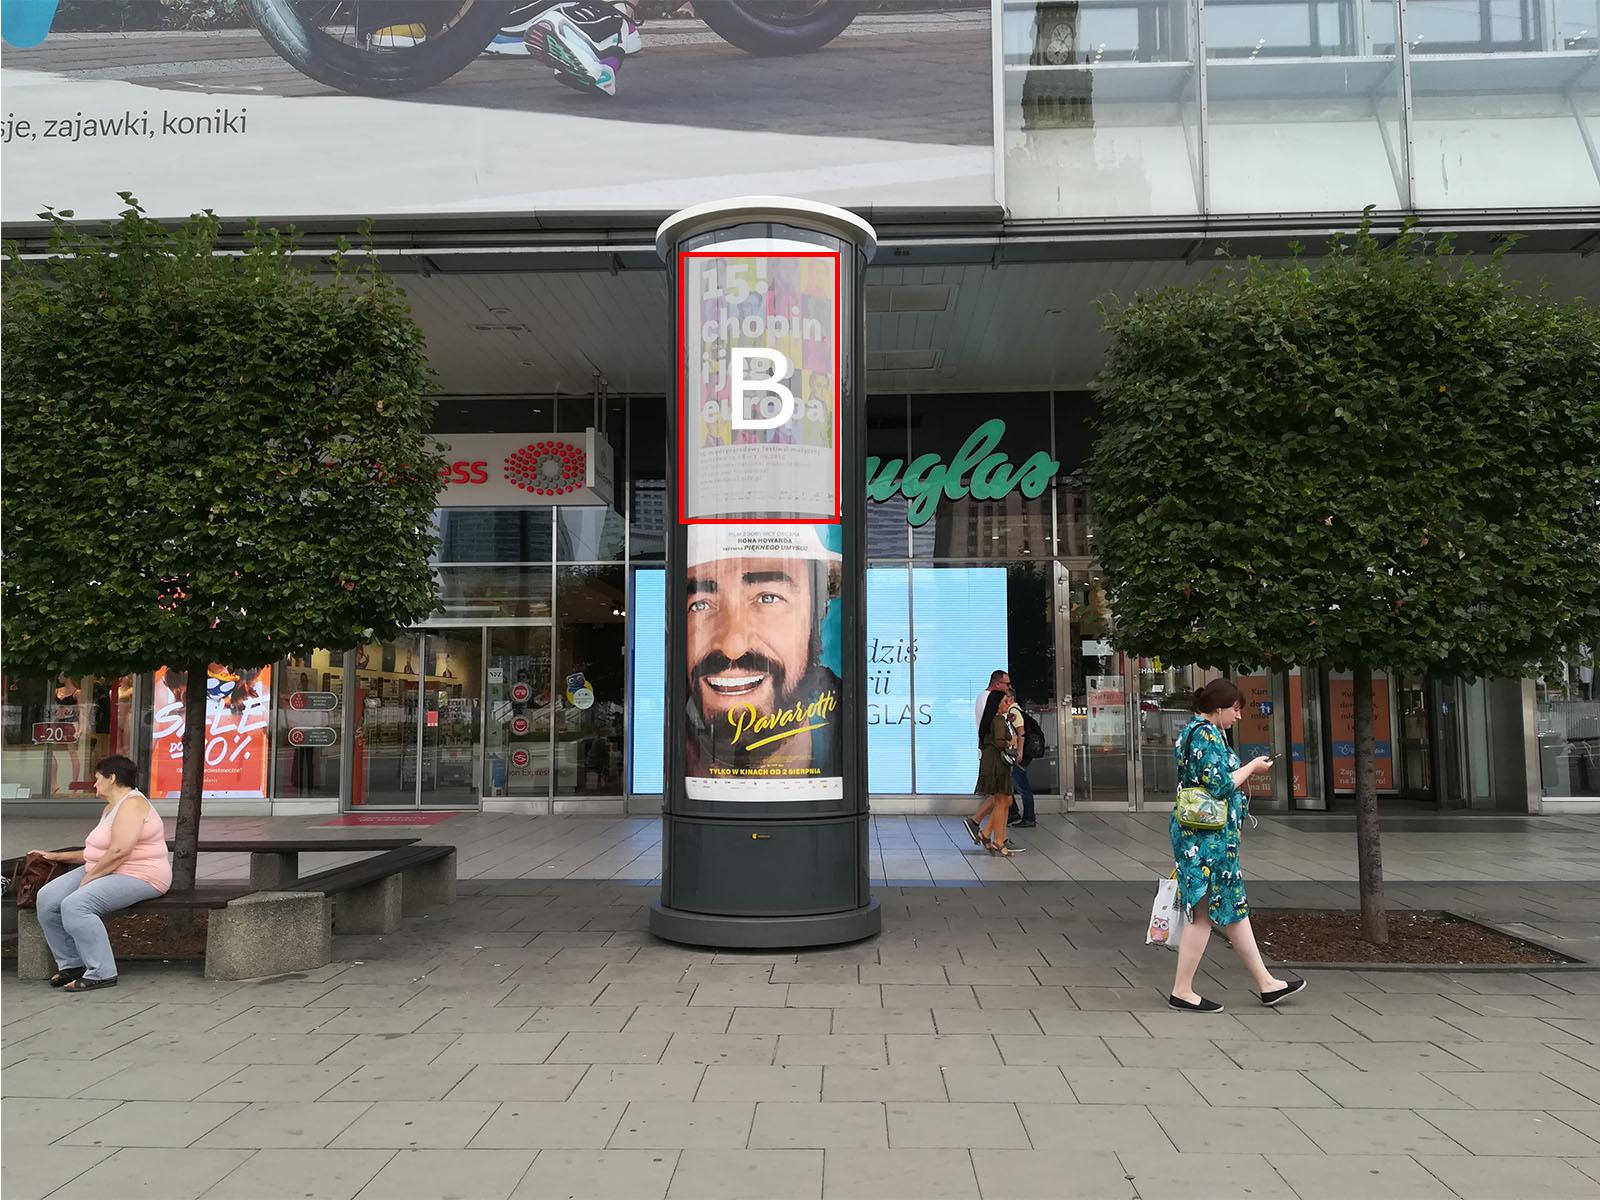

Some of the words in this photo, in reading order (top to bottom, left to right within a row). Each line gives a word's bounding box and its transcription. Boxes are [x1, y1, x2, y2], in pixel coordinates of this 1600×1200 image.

[43, 110, 155, 142] zajawki,
[162, 108, 247, 135] koniki
[702, 306, 822, 347] chopin
[728, 691, 837, 745] Pavarotti
[789, 767, 821, 775] SIERPNIA
